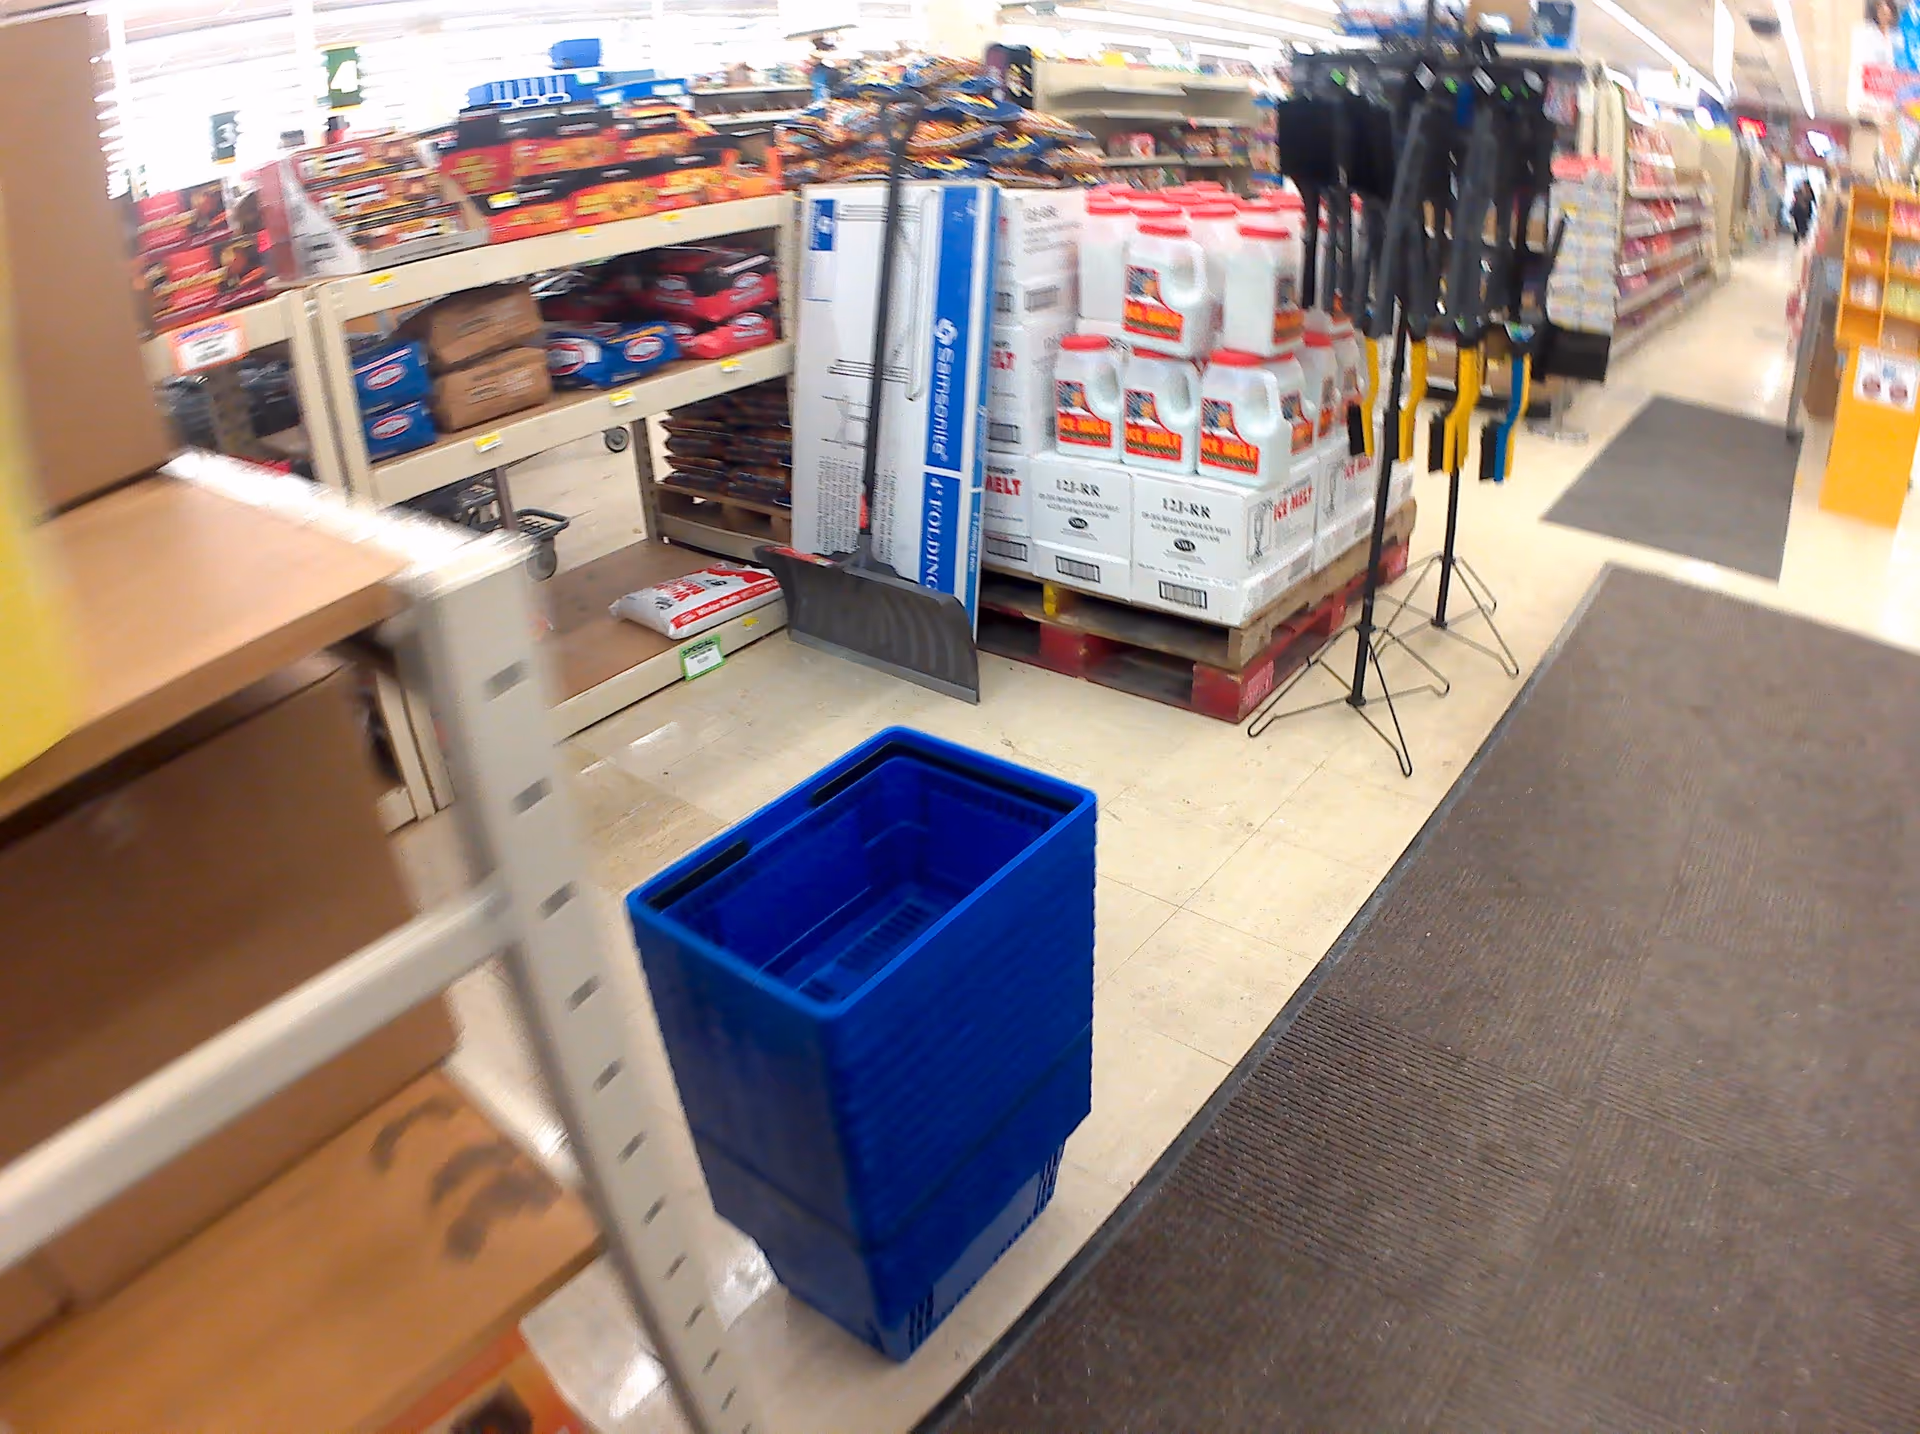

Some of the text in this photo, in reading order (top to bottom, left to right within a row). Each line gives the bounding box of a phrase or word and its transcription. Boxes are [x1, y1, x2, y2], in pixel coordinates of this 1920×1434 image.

[329, 60, 358, 93] 4
[215, 122, 237, 148] 3
[932, 347, 954, 454] Samsonite
